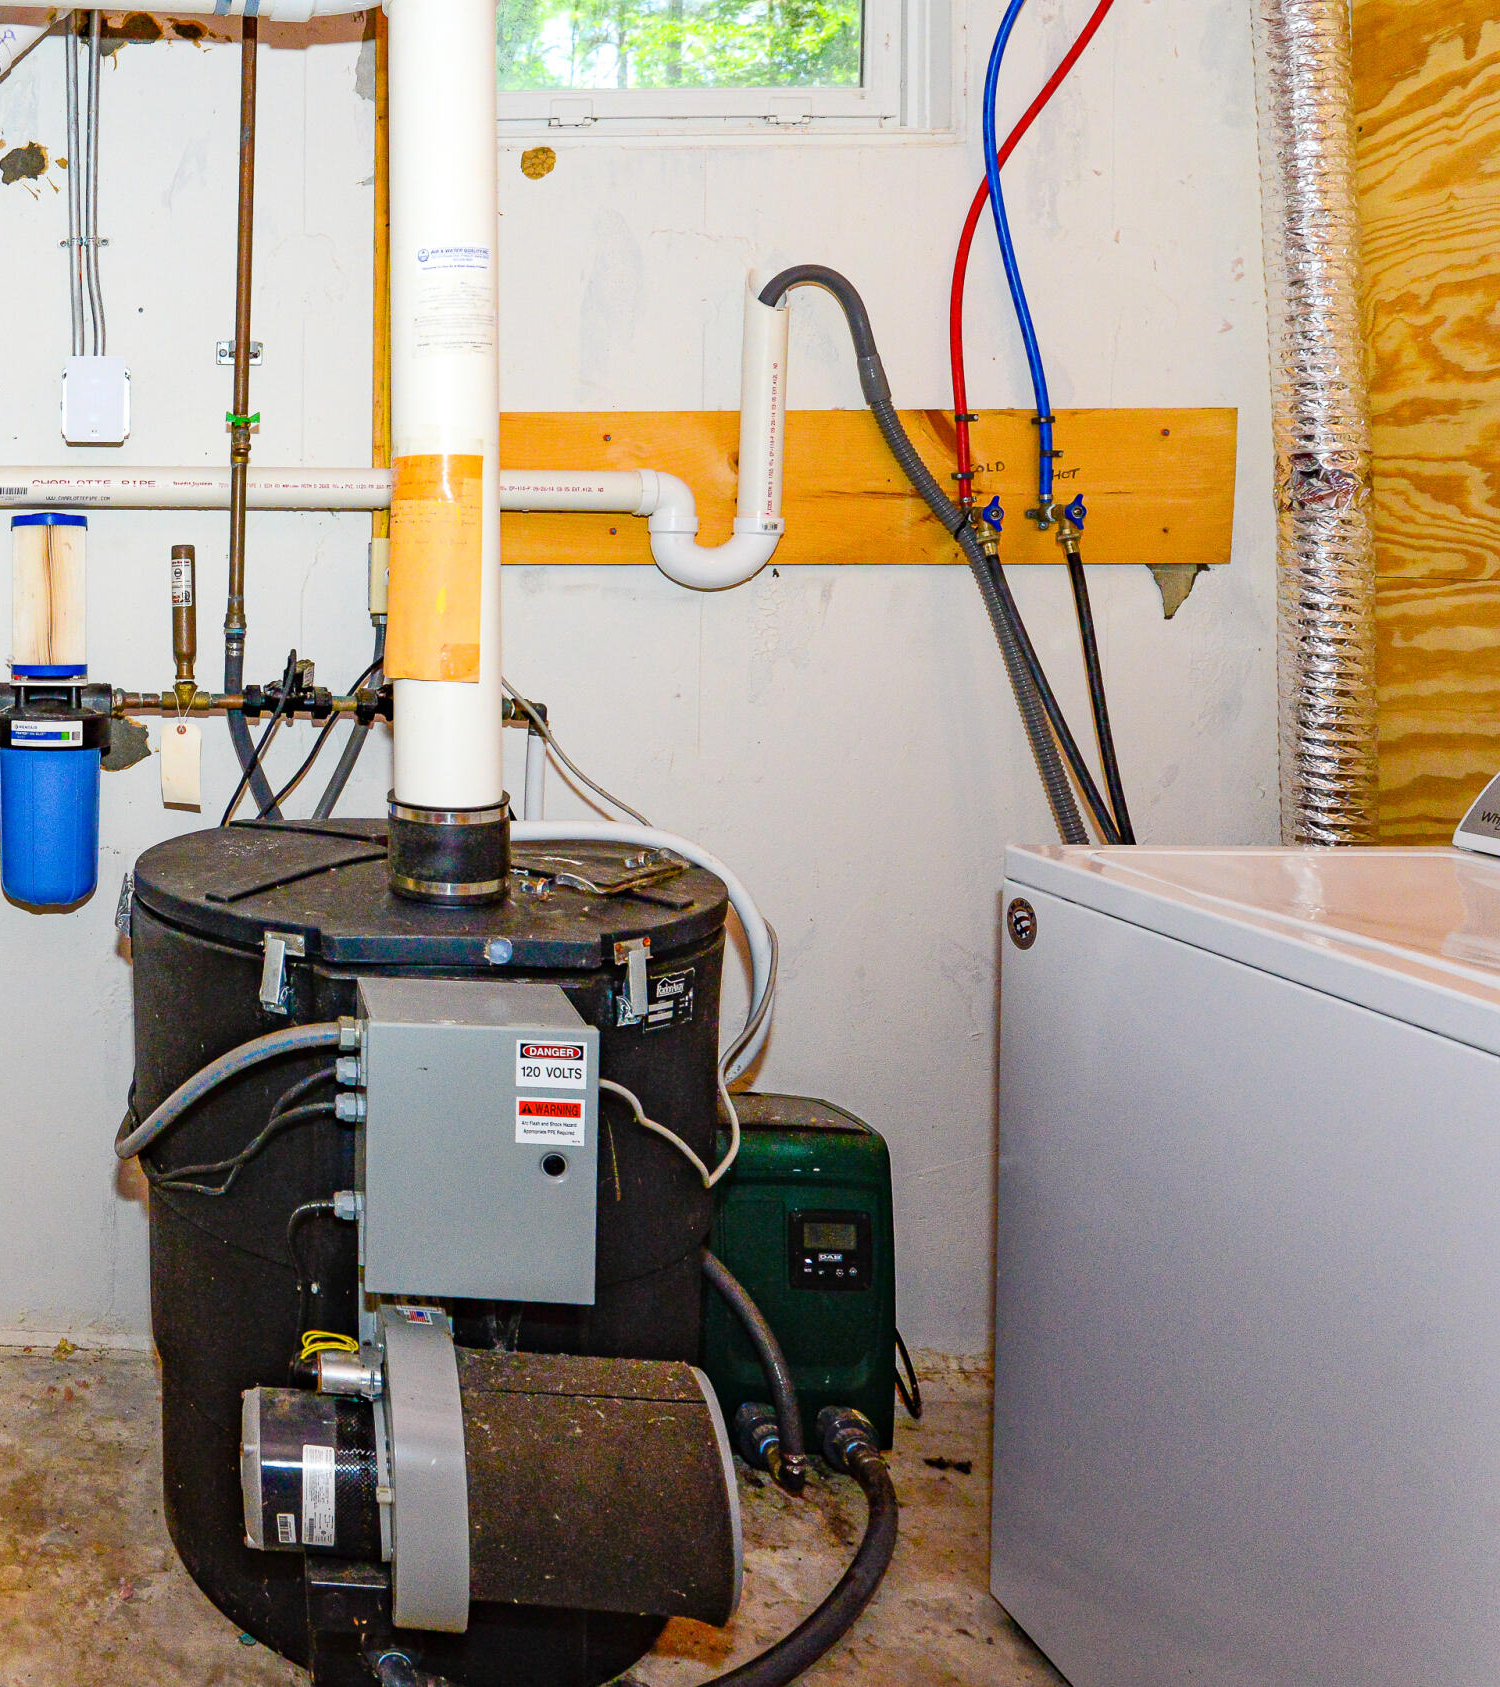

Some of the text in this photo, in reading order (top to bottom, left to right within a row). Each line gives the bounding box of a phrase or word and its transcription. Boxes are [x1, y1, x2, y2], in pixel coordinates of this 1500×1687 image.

[970, 461, 1005, 473] COLD
[1052, 468, 1081, 480] HOT
[529, 1047, 575, 1057] DANGER
[521, 1066, 582, 1080] 120 VOLTS
[536, 1103, 579, 1116] WARNING
[818, 1253, 843, 1262] DAB
